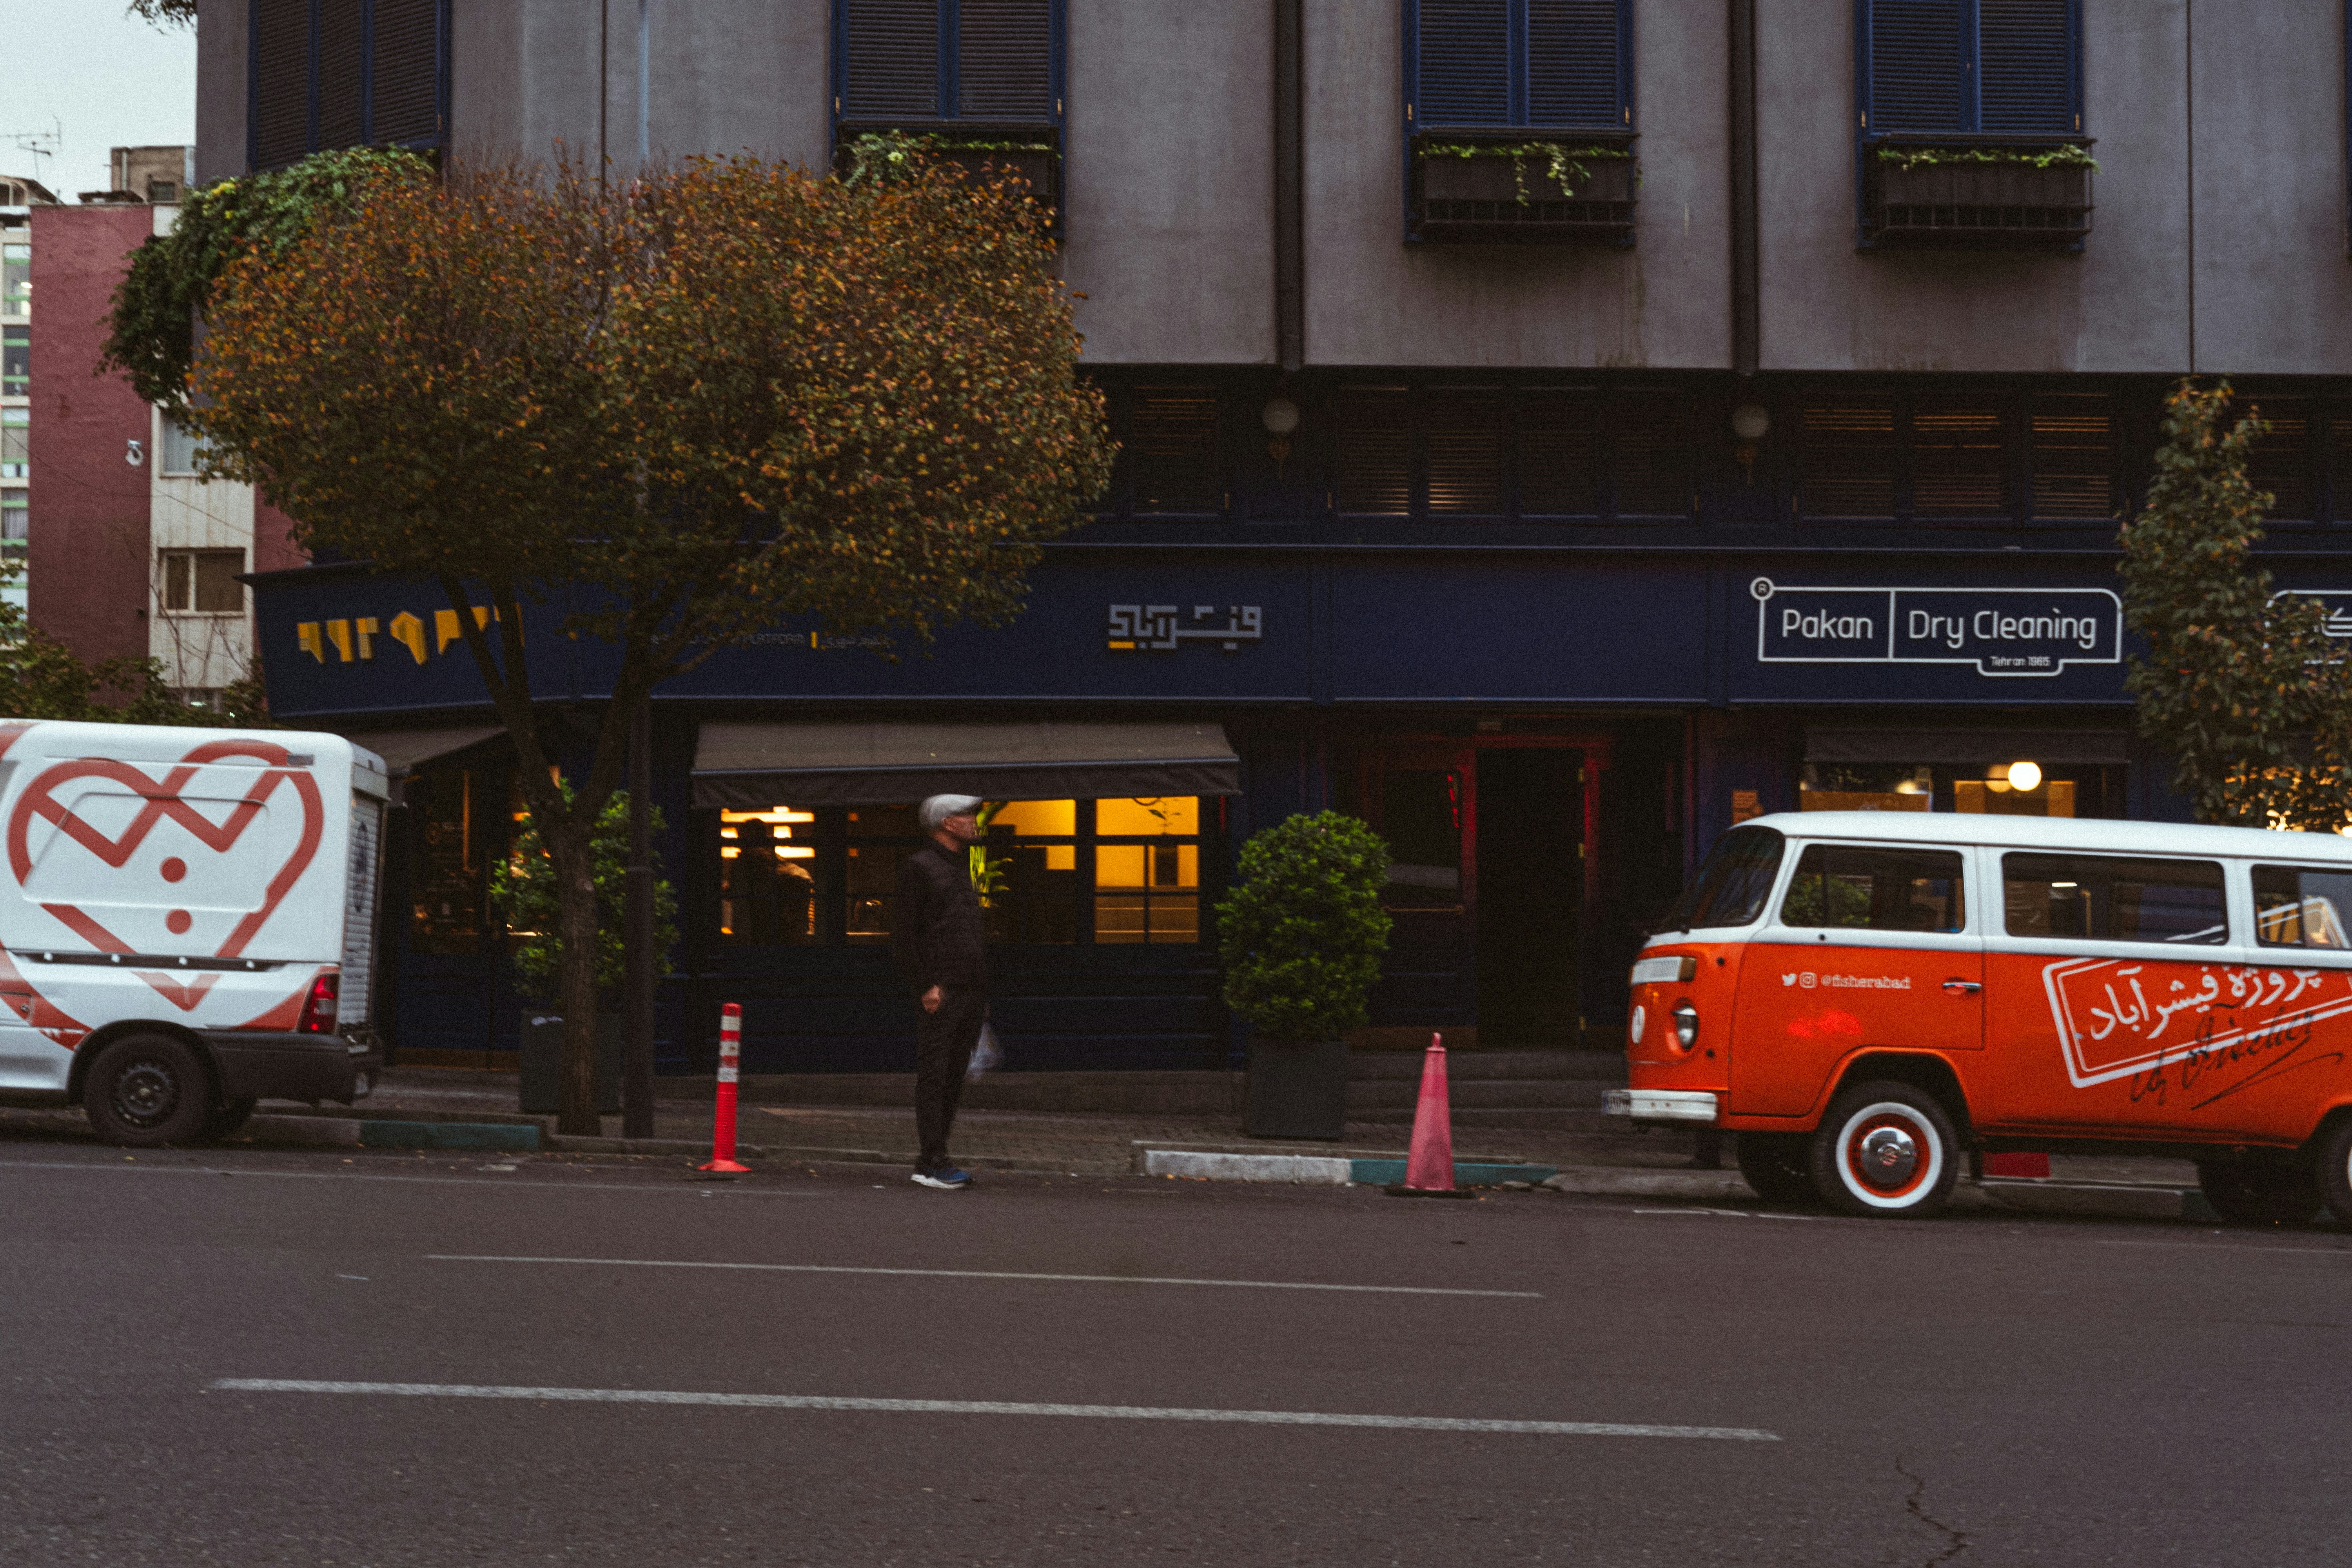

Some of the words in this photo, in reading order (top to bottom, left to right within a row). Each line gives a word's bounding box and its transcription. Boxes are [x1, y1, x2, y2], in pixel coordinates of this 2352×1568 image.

[1782, 609, 1872, 638] Pakan
[1909, 611, 1964, 649] Dry
[1974, 608, 2096, 649] Cleaning
[1990, 656, 2025, 666] Tehran
[1820, 973, 1911, 989] @fisherabad
[2091, 965, 2219, 1040] فیشرآباد
